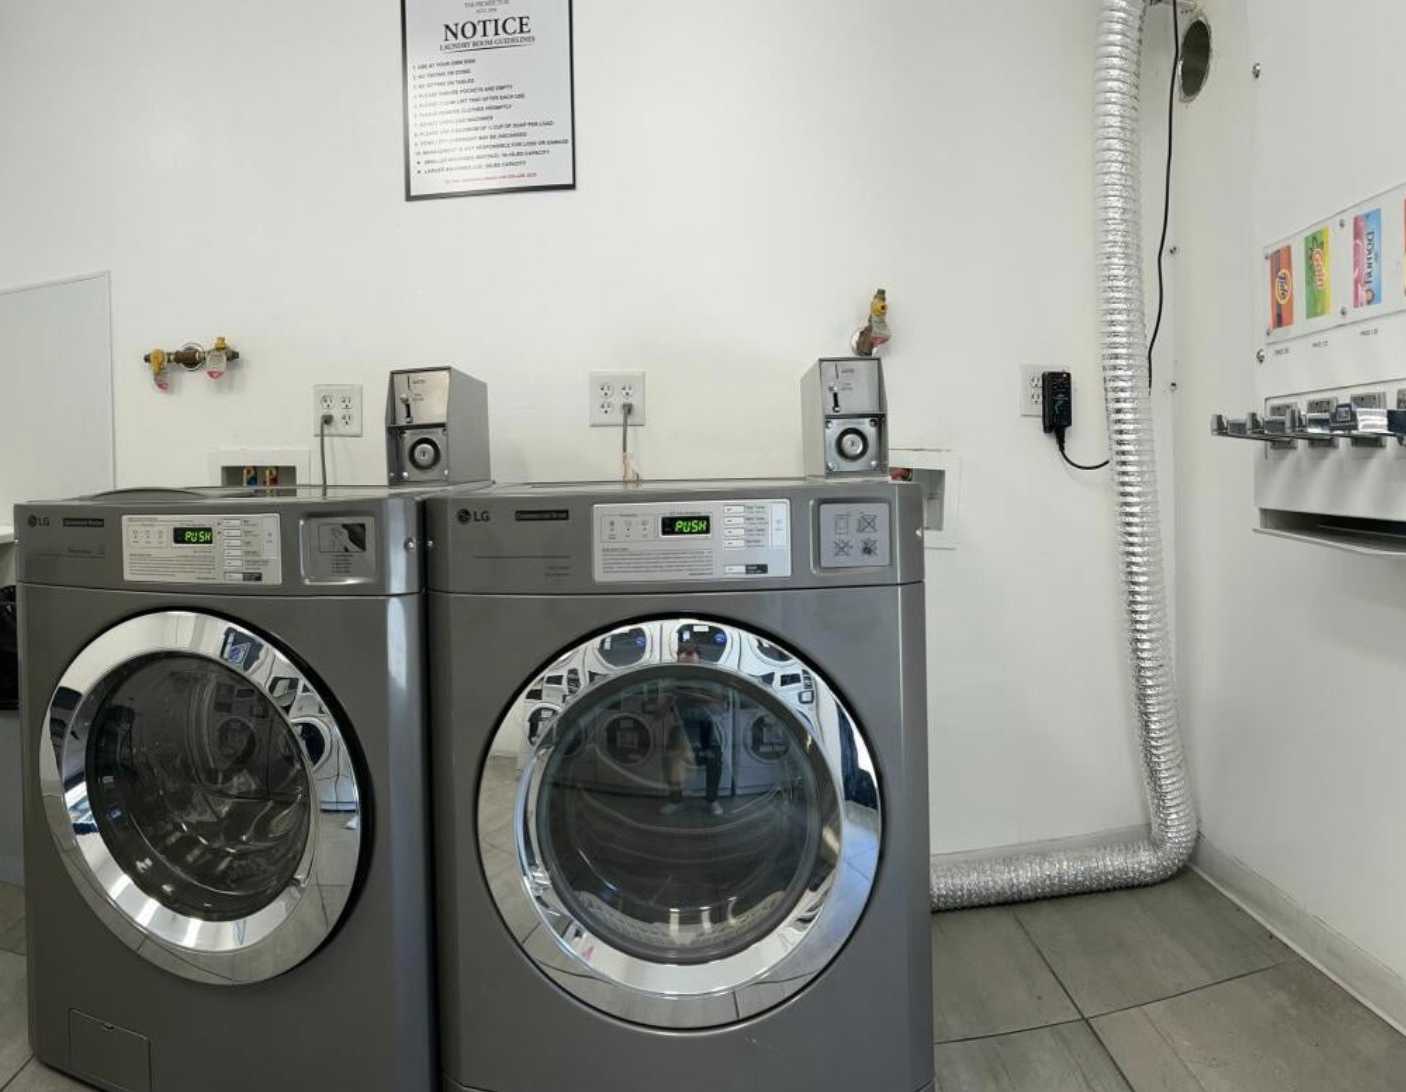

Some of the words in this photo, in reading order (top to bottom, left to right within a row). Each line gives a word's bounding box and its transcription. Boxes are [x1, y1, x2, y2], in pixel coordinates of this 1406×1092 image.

[443, 16, 531, 41] NOTICE
[474, 510, 490, 522] LG
[674, 520, 707, 532] PUSH
[184, 530, 212, 542] PUSH
